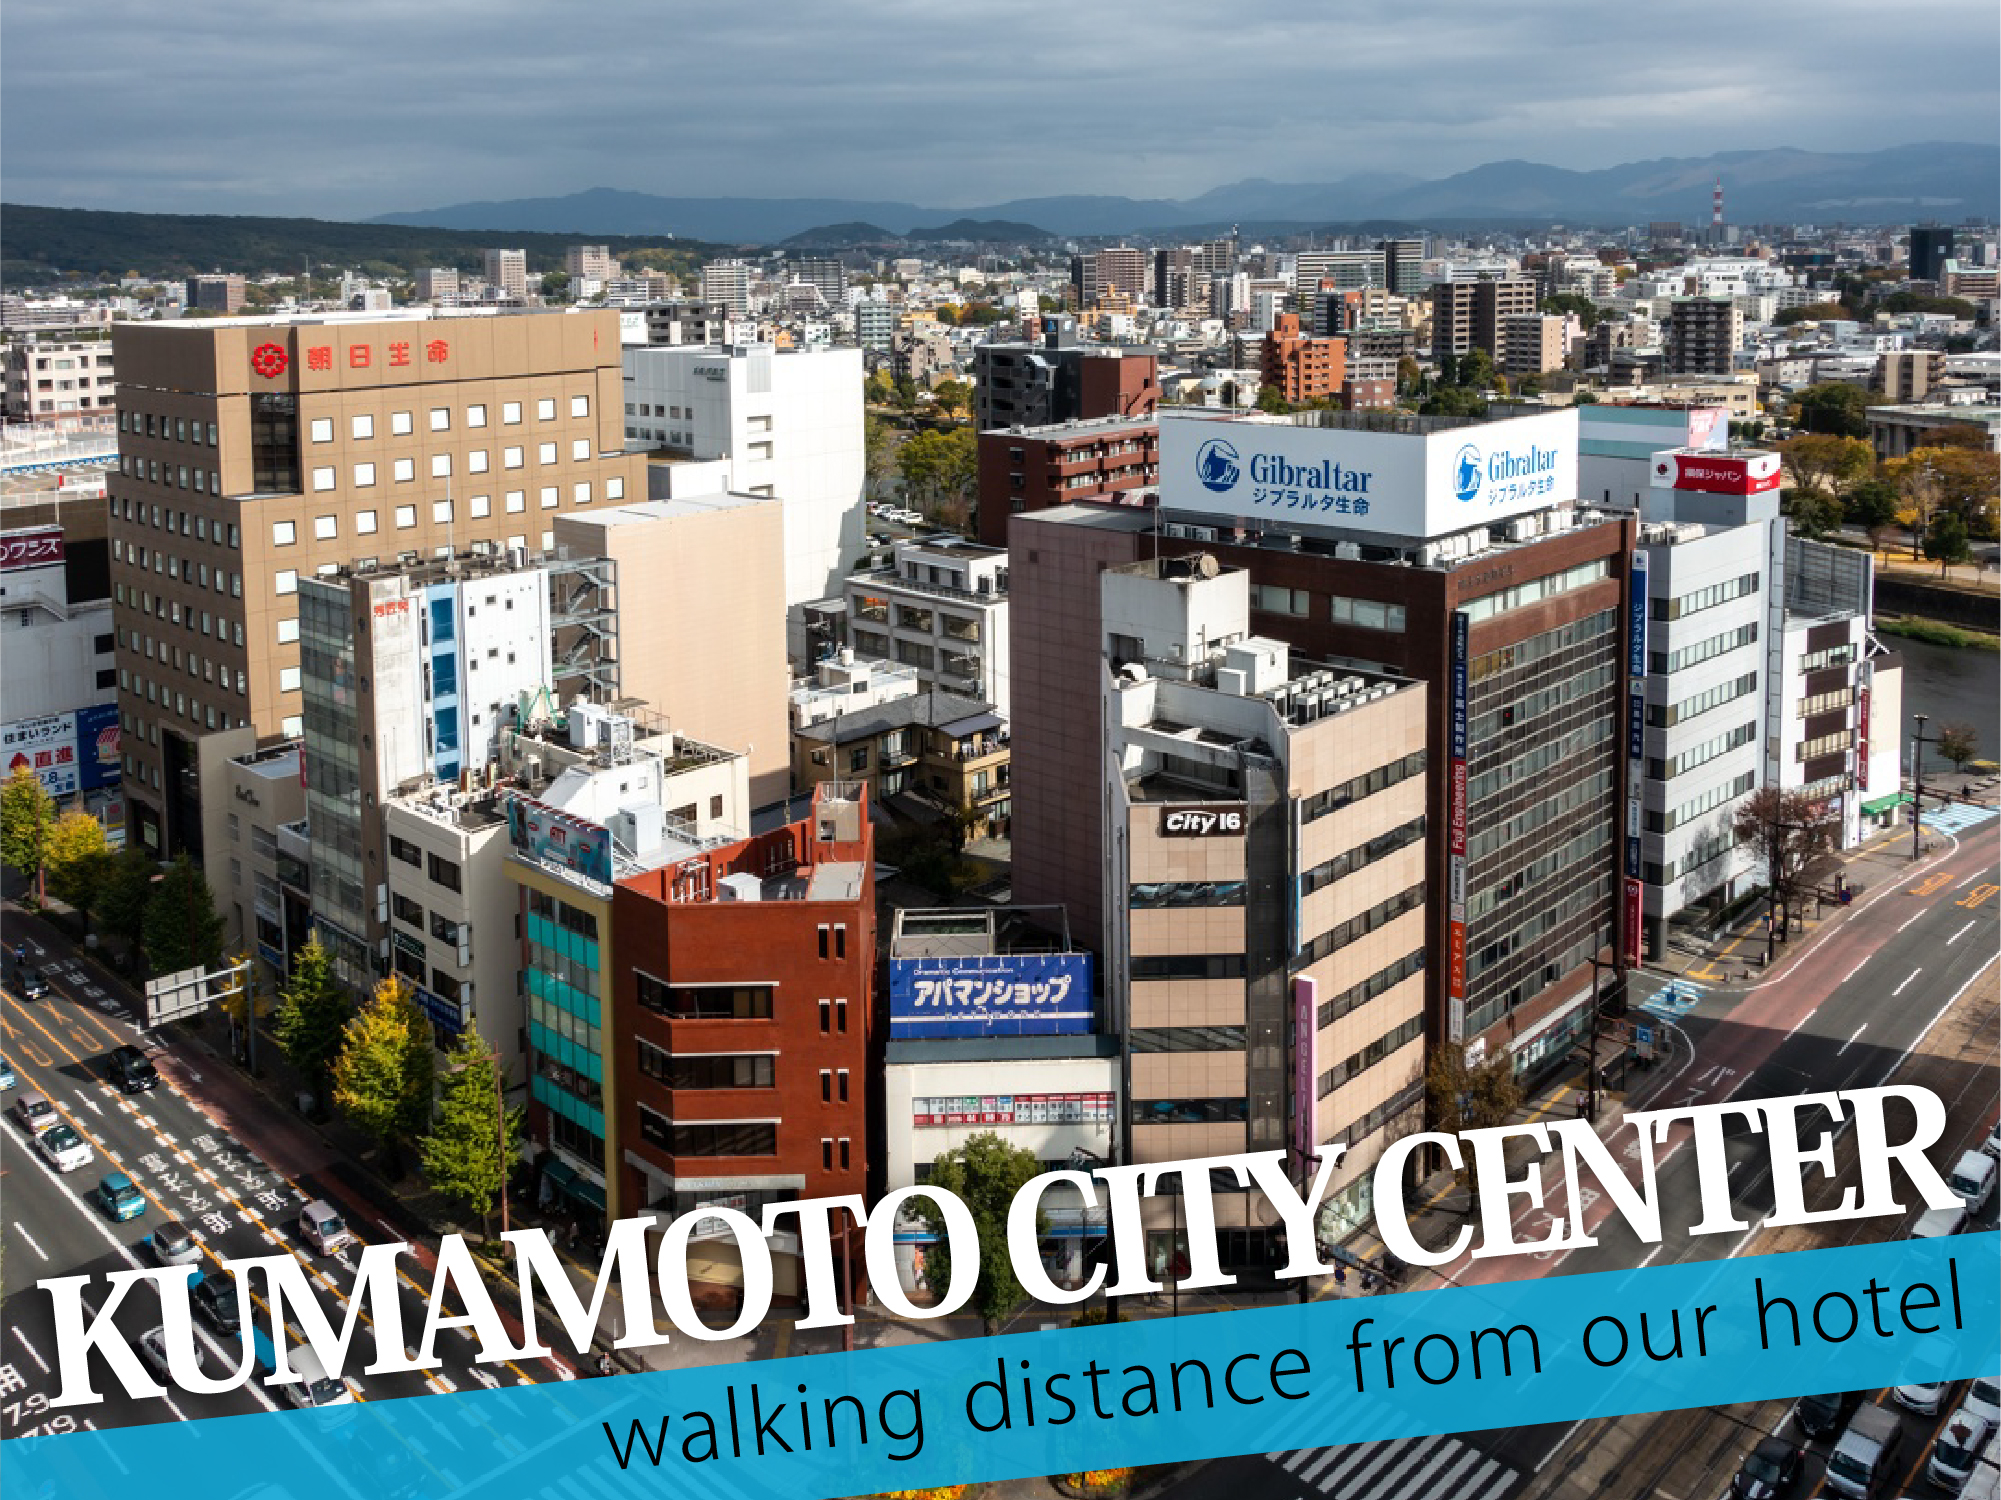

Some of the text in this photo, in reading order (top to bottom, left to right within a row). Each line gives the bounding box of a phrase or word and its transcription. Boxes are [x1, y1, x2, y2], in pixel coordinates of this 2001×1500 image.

[308, 339, 449, 371] 朝日生命
[1250, 453, 1373, 494] Gibraltar
[1487, 445, 1559, 483] Gibraltar
[1453, 764, 1465, 827] Engineering
[1166, 811, 1241, 834] City 16
[1453, 829, 1464, 849] Fuji
[913, 975, 1072, 1007] アパマンショップ
